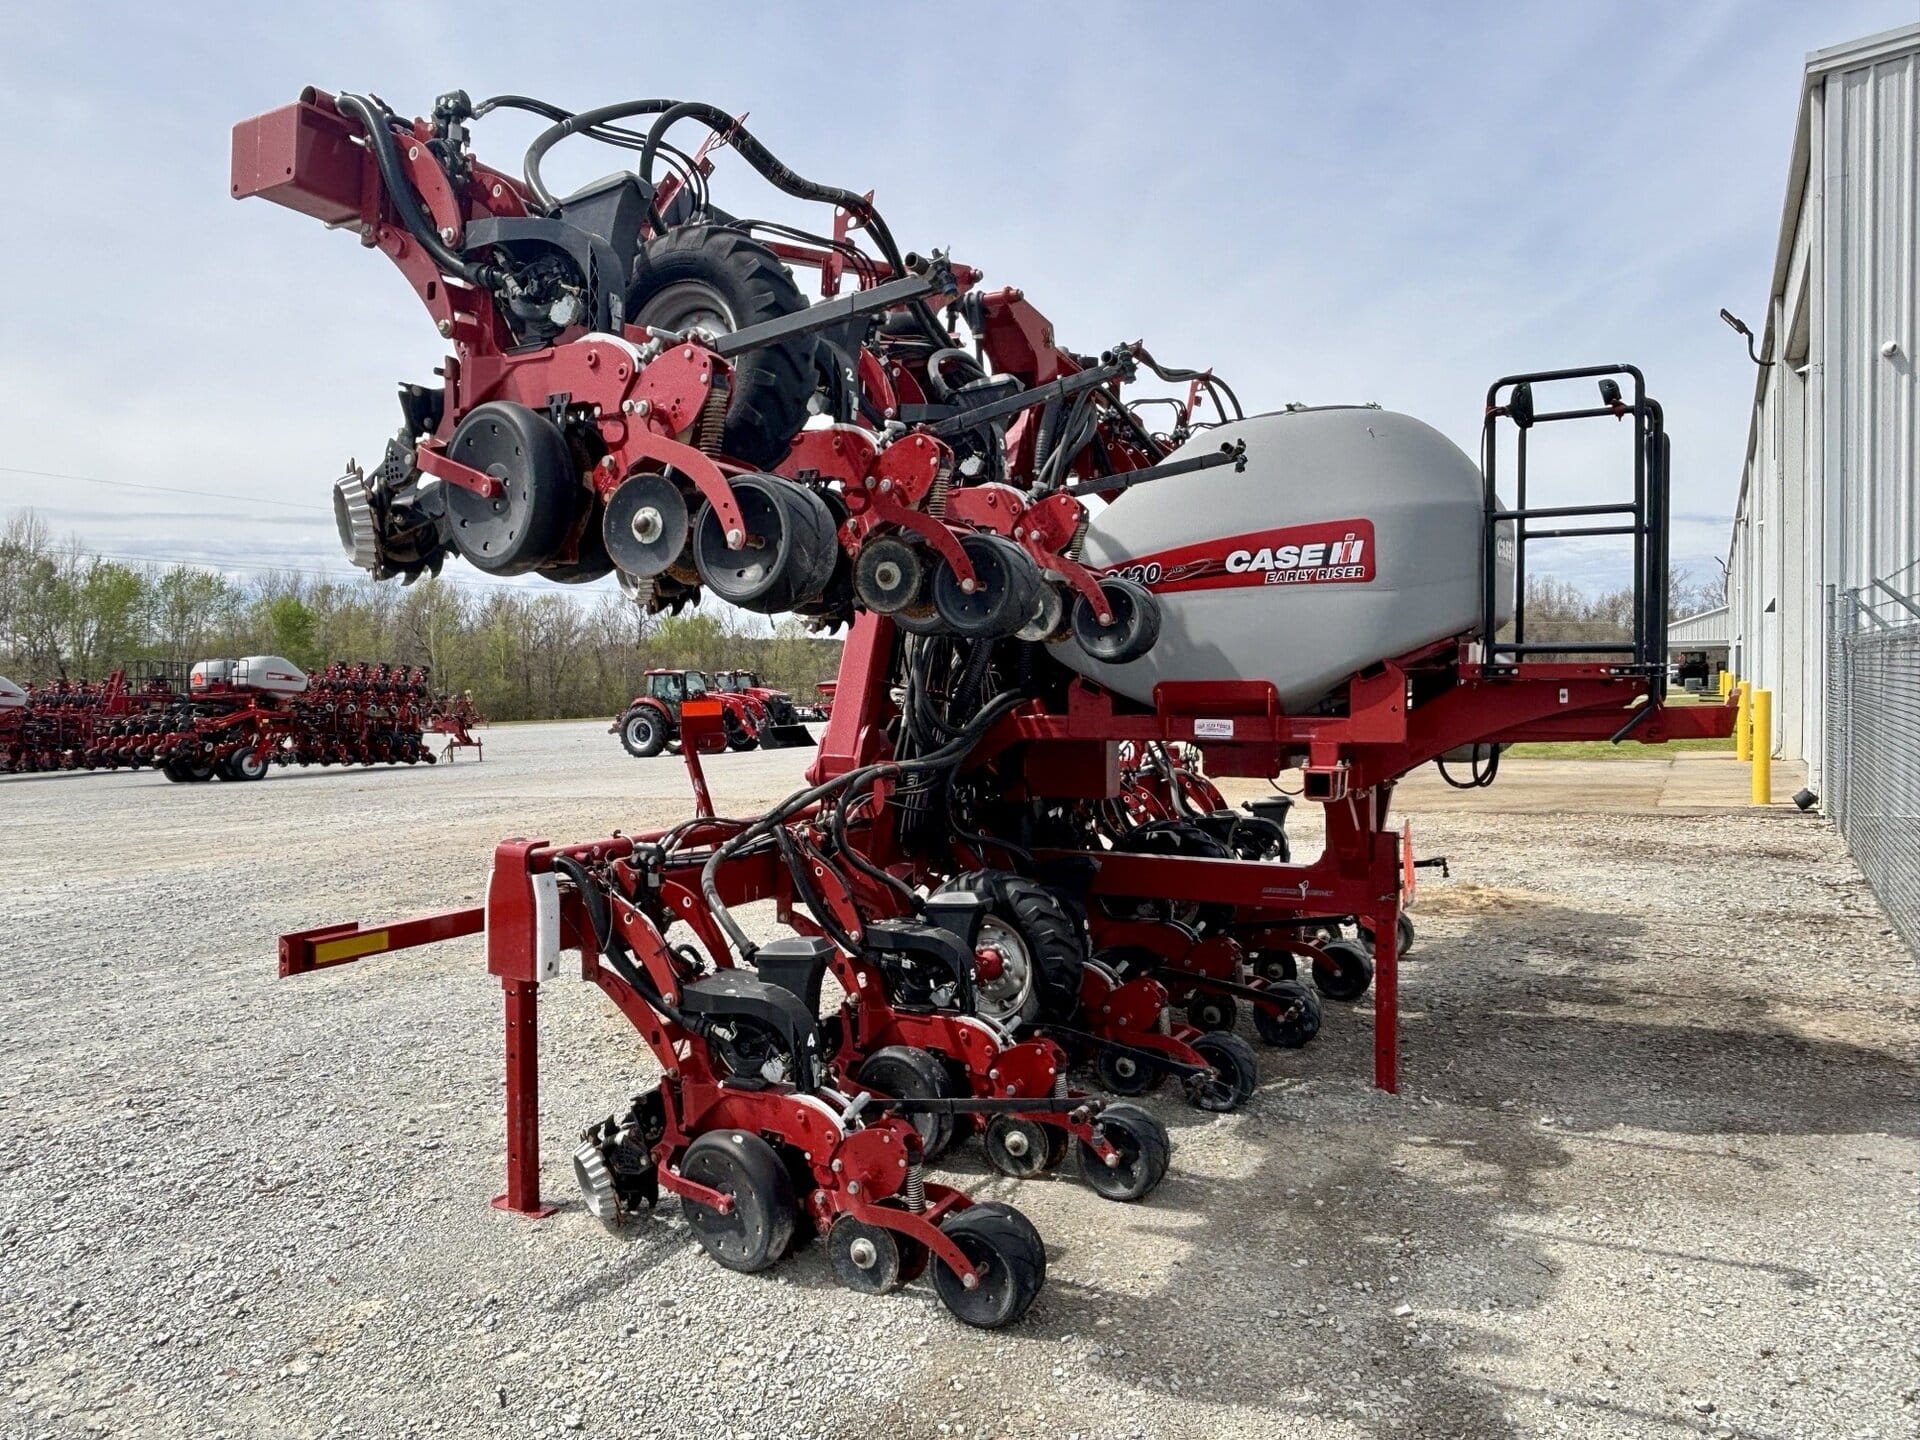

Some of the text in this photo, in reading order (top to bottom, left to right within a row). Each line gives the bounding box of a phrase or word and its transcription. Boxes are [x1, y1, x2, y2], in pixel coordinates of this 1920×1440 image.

[845, 367, 854, 382] 2
[1225, 543, 1326, 573] CASE
[1265, 565, 1365, 584] EARLY RISER
[969, 968, 976, 981] 5
[807, 1032, 816, 1048] 4
